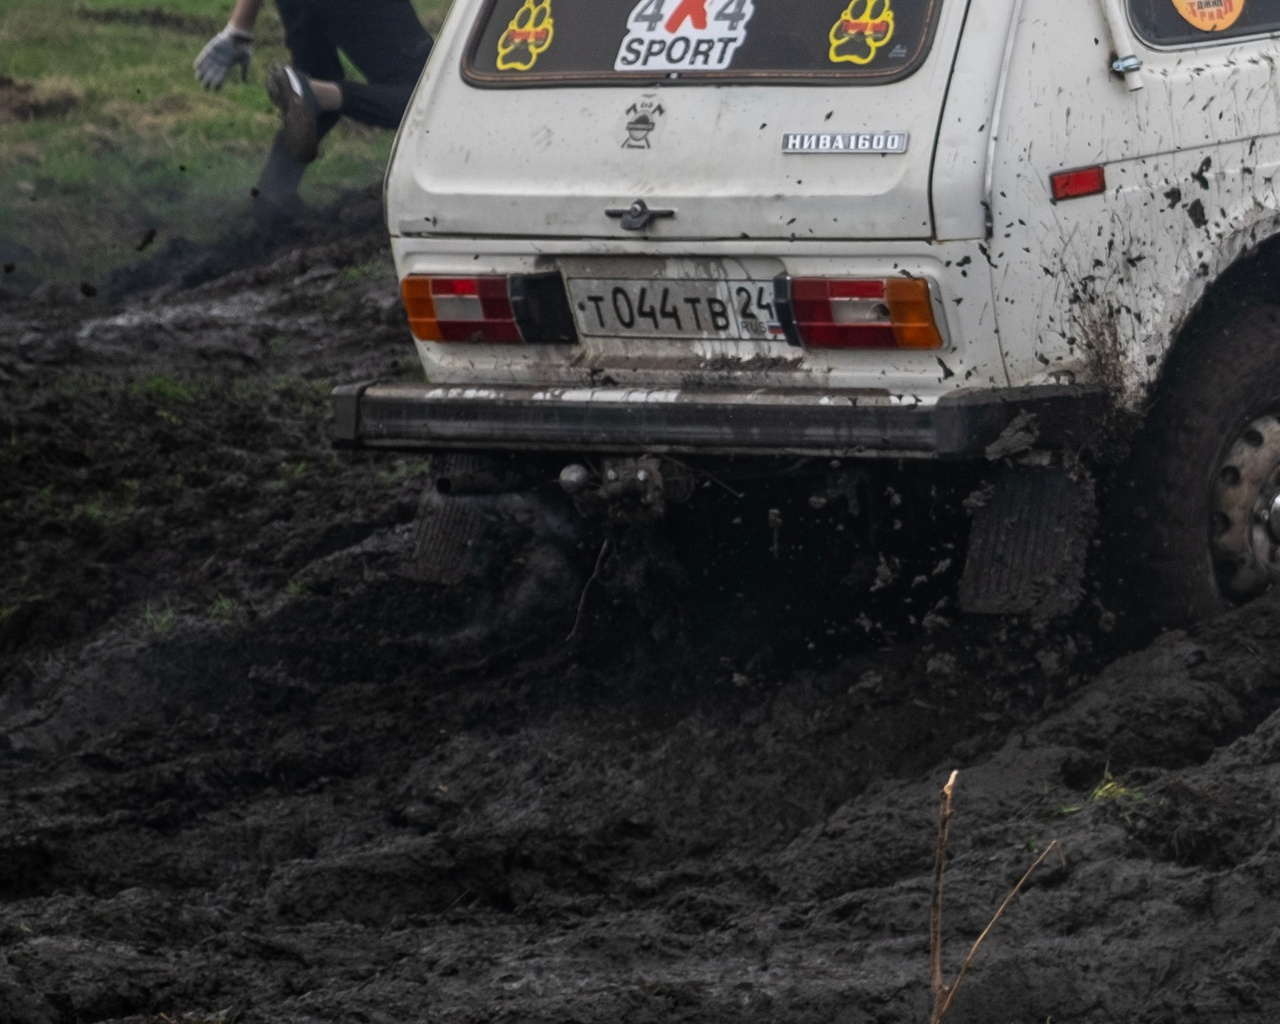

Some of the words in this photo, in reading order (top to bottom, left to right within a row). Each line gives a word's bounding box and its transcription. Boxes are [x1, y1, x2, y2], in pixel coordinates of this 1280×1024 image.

[620, 36, 738, 66] SPORT
[787, 134, 844, 150] НИВА
[849, 134, 899, 150] 1600
[736, 286, 774, 319] 24
